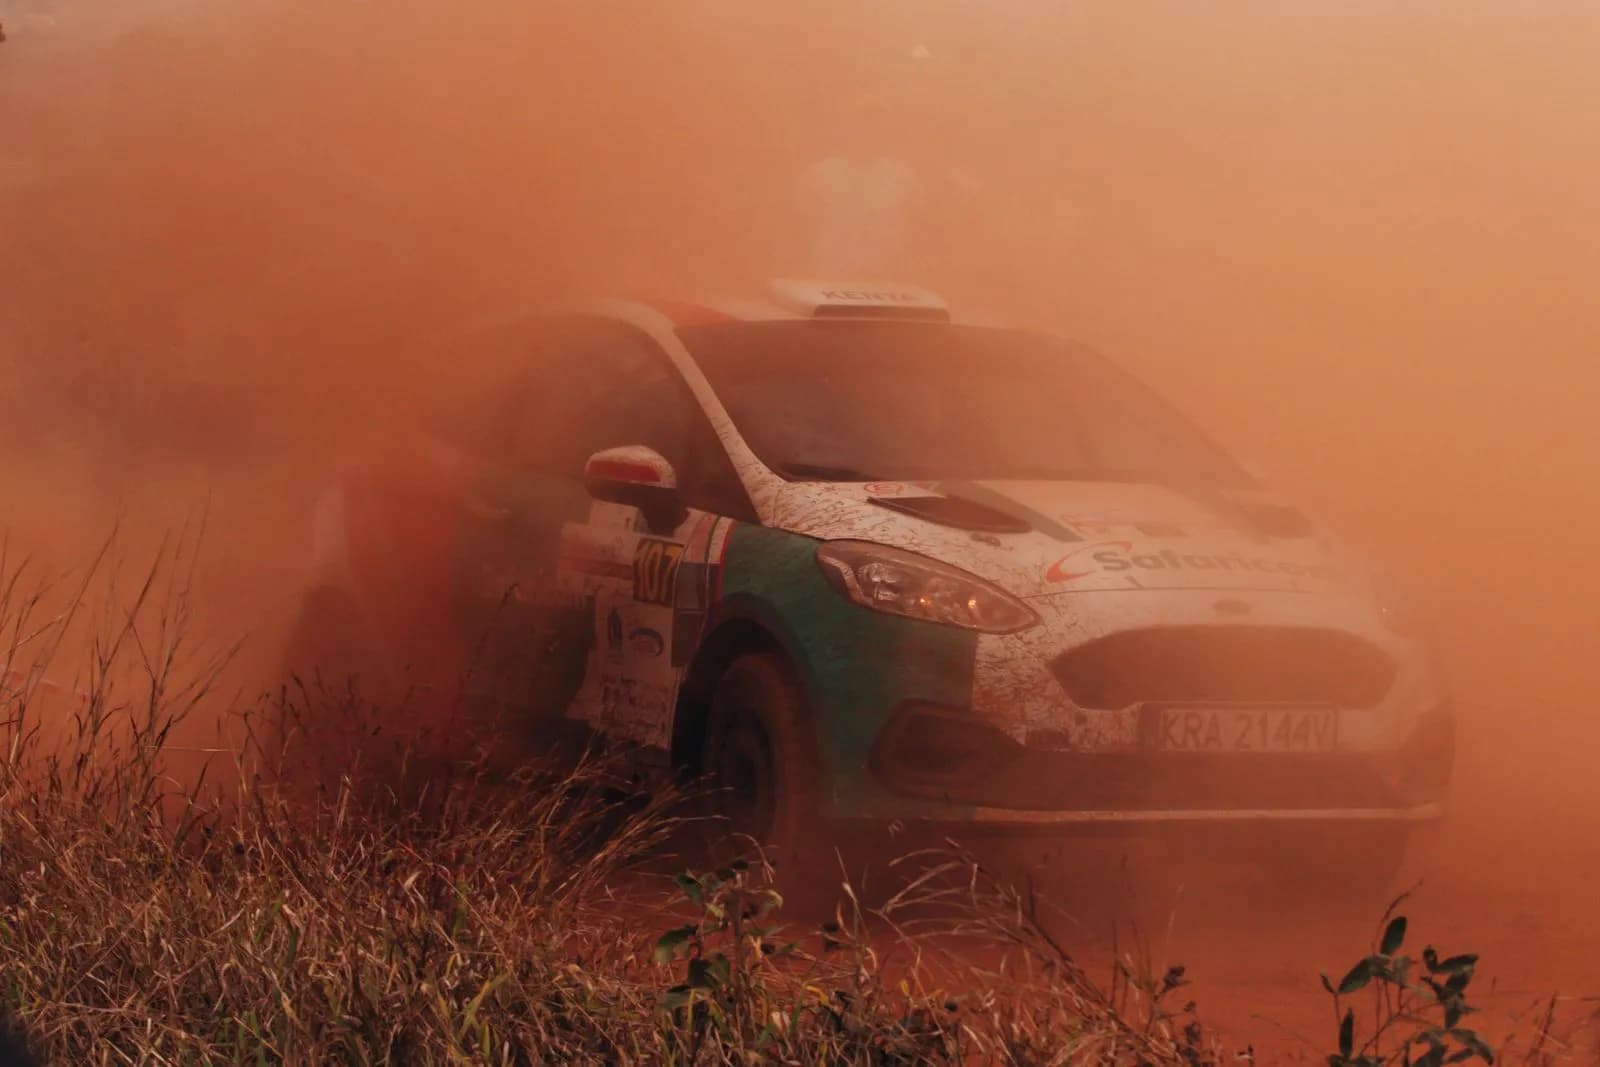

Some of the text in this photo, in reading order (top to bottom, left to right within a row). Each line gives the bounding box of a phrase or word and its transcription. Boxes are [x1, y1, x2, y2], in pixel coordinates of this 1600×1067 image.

[638, 540, 681, 602] 107
[1093, 550, 1340, 577] Safarico
[1161, 711, 1331, 749] KRA 2144V
